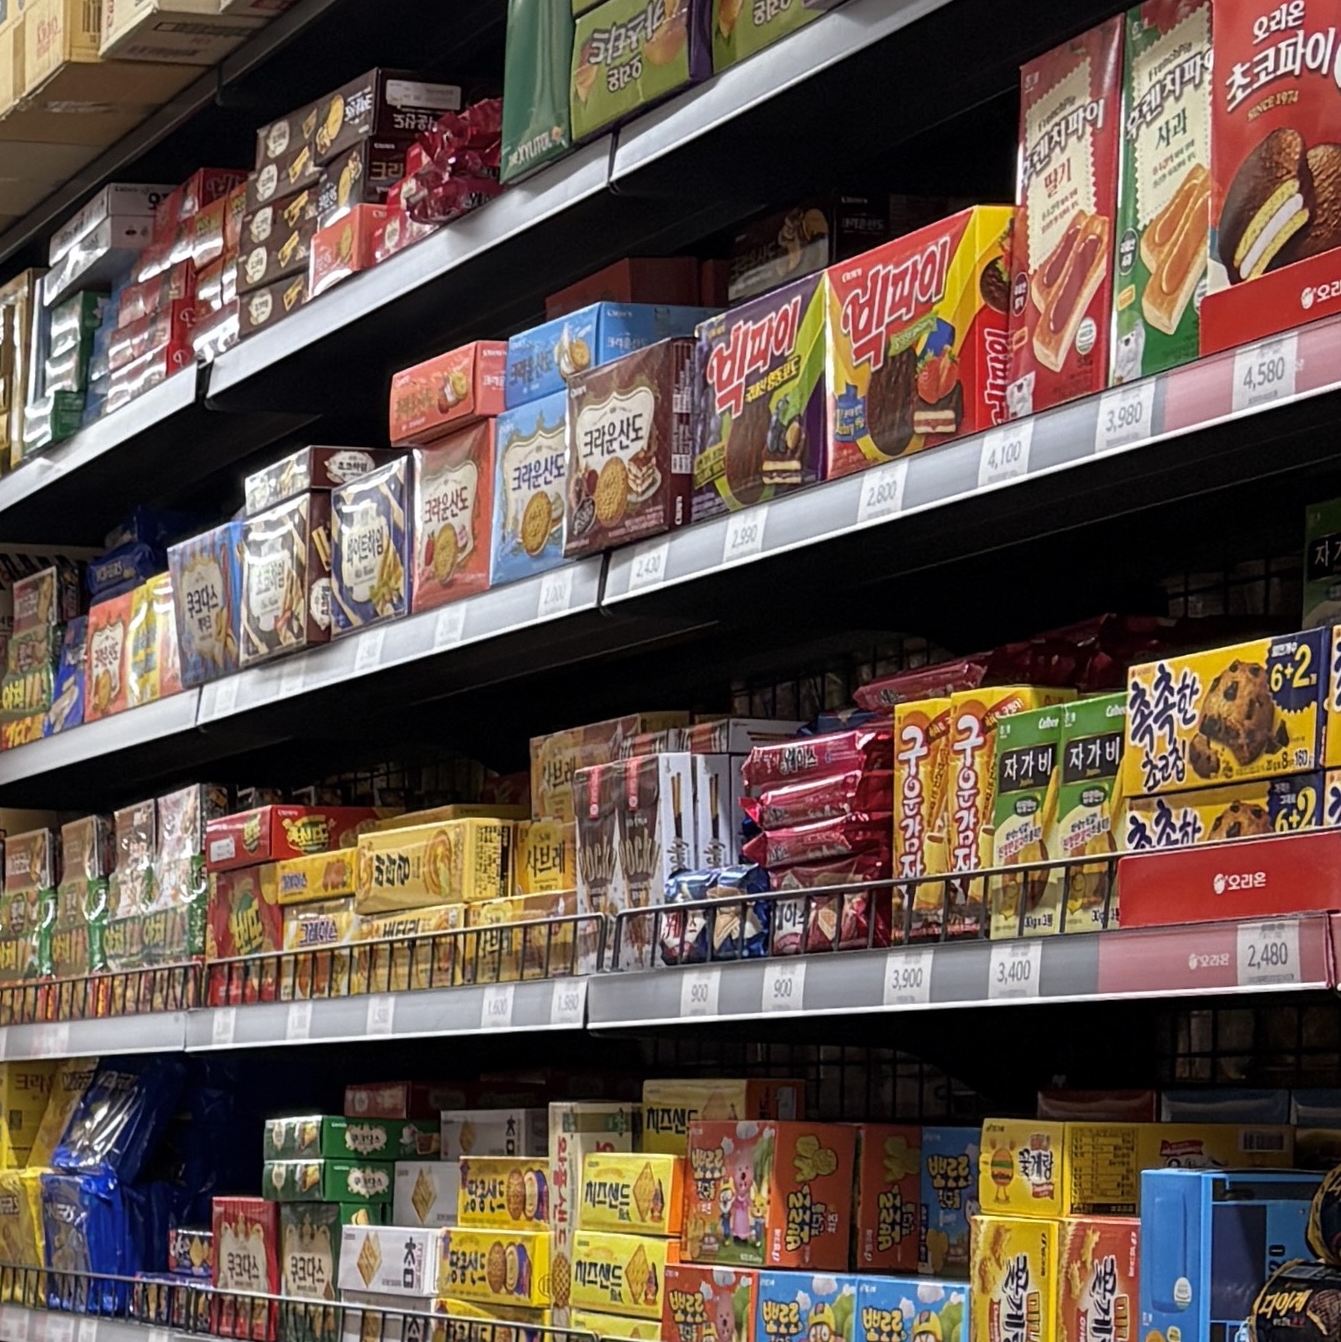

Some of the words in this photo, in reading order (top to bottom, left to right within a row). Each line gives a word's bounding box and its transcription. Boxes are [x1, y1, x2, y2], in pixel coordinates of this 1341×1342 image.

[589, 0, 666, 65] 카스타드
[1253, 1, 1305, 44] 오리온
[607, 58, 643, 92] 오리온
[1226, 28, 1335, 112] 초코파이
[1156, 107, 1188, 150] 사과
[1044, 158, 1071, 199] 딸기
[841, 237, 950, 371] 빅파이
[707, 296, 802, 419] 빅파이
[1243, 358, 1286, 389] 4,580
[1105, 402, 1143, 429] 3,980
[582, 413, 645, 459] 크라운산도
[512, 453, 566, 492] 크라운산도
[423, 486, 470, 524] 크라운산도
[1129, 662, 1201, 753] 촉촉한
[1003, 746, 1052, 781] 자가비
[1069, 736, 1120, 768] 자가비
[1142, 736, 1187, 793] 초코칩
[544, 761, 575, 792] 사브레
[525, 842, 566, 878] 사브레
[1227, 872, 1267, 891] 오리온
[997, 961, 1031, 983] 3,400
[1247, 942, 1289, 969] 2,480
[774, 979, 793, 998] 900
[892, 969, 923, 990] 3,900
[646, 1108, 699, 1133] 치즈샌드
[691, 1147, 726, 1180] 뽀로로
[1018, 1148, 1055, 1183] 꽃게랑
[584, 1180, 631, 1210] 치즈샌드
[227, 1251, 260, 1281] 쿠크다스
[290, 1255, 324, 1285] 쿠크다스
[448, 1247, 487, 1285] 땅콩샌드
[575, 1260, 623, 1290] 치즈샌드
[669, 1288, 707, 1324] 뽀로로
[761, 1300, 804, 1336] 뽀로로
